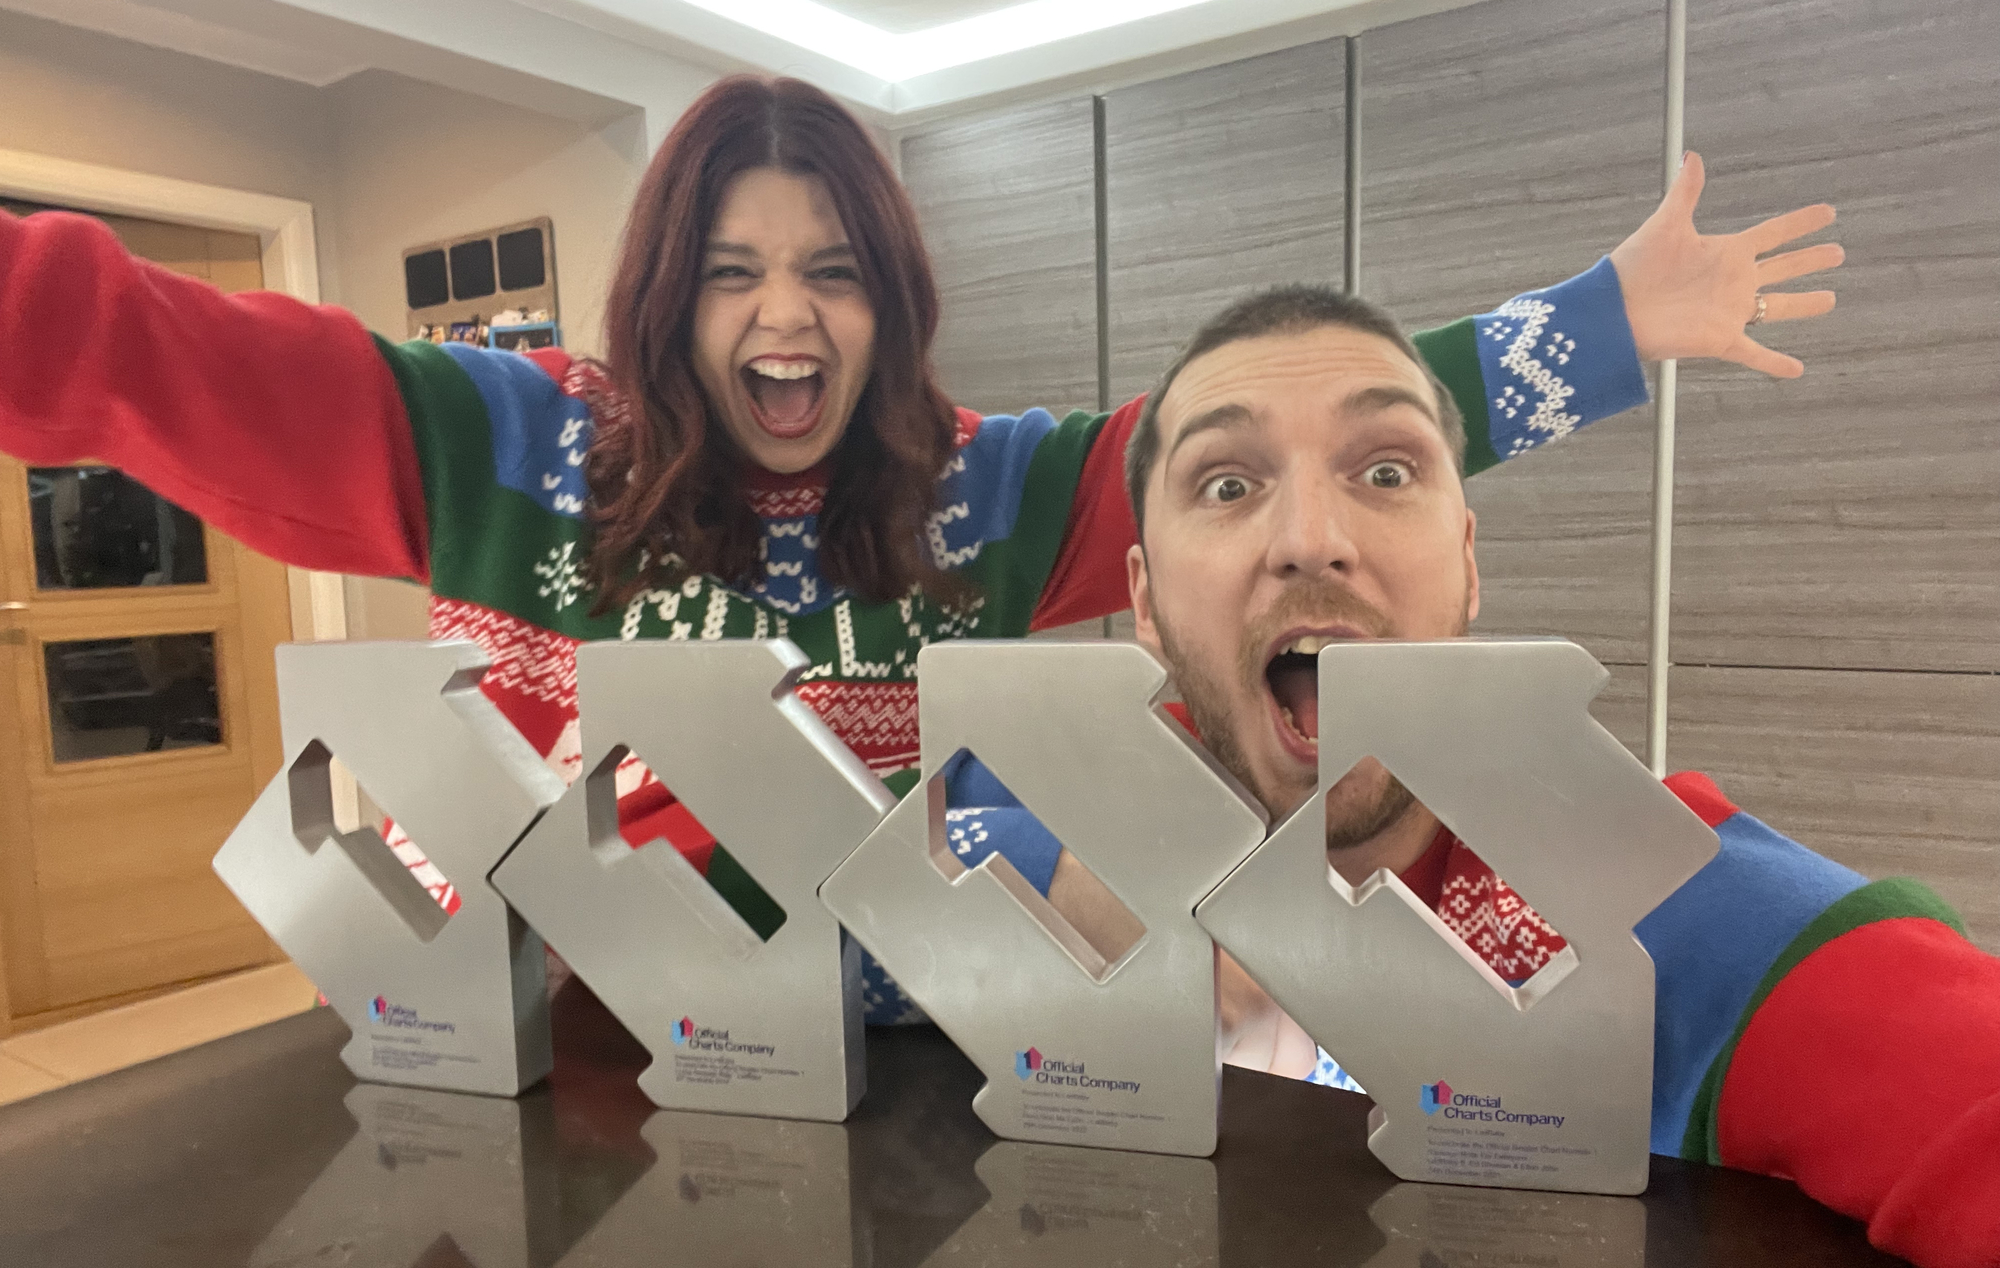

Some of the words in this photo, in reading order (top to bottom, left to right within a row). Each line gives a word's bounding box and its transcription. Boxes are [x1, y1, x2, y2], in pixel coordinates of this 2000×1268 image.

[694, 1027, 729, 1040] Official
[689, 1038, 724, 1051] Charts
[725, 1041, 775, 1057] Company
[1043, 1060, 1085, 1074] Official
[1036, 1072, 1078, 1087] Charts
[1079, 1075, 1141, 1093] Company
[1453, 1093, 1501, 1108] Official
[1444, 1107, 1493, 1122] Charts
[1495, 1109, 1565, 1128] Company
